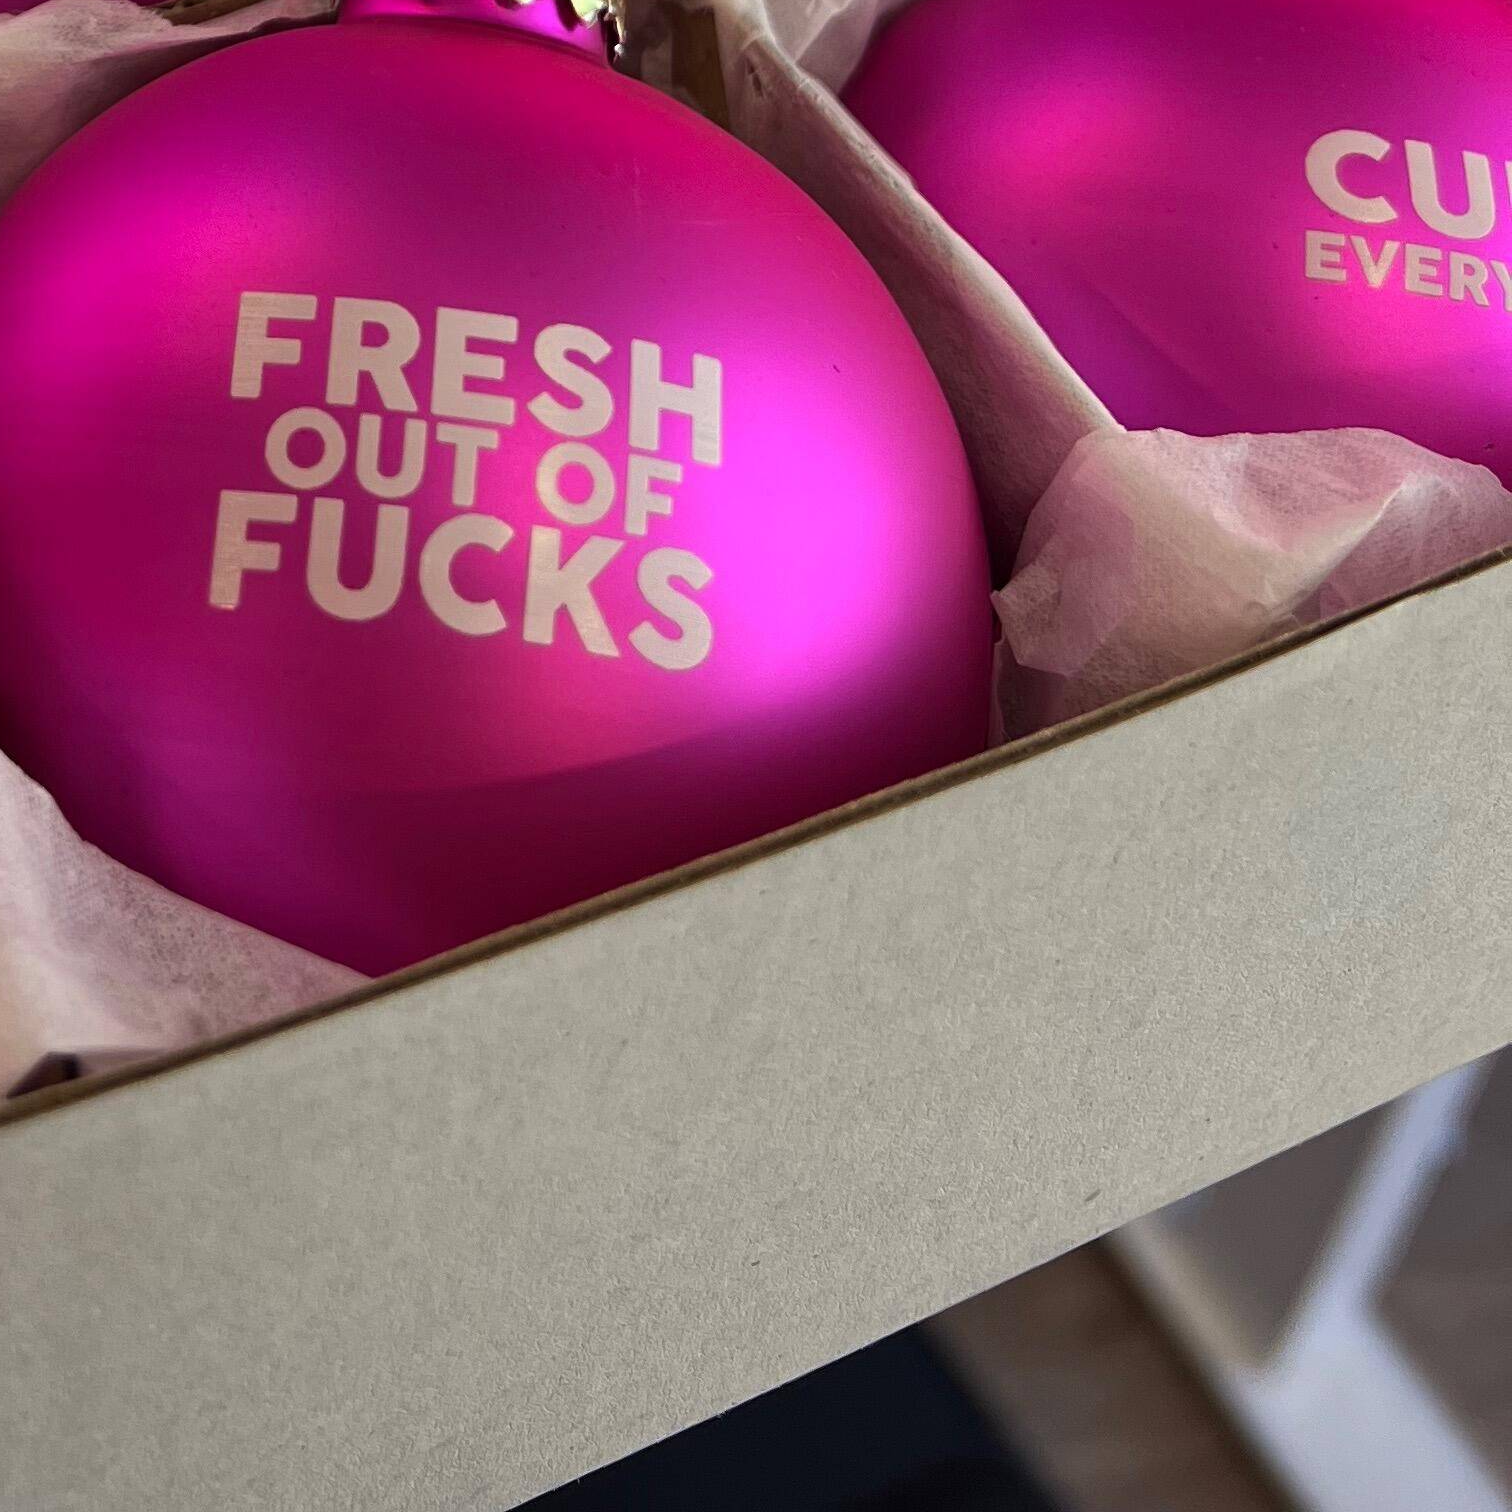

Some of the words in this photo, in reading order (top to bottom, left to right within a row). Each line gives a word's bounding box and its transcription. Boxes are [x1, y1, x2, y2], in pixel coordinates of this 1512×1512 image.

[1305, 128, 1512, 240] CU
[230, 290, 723, 468] FRESH
[264, 406, 500, 507] OUT
[535, 440, 684, 537] OF
[208, 488, 715, 672] FUCKS
